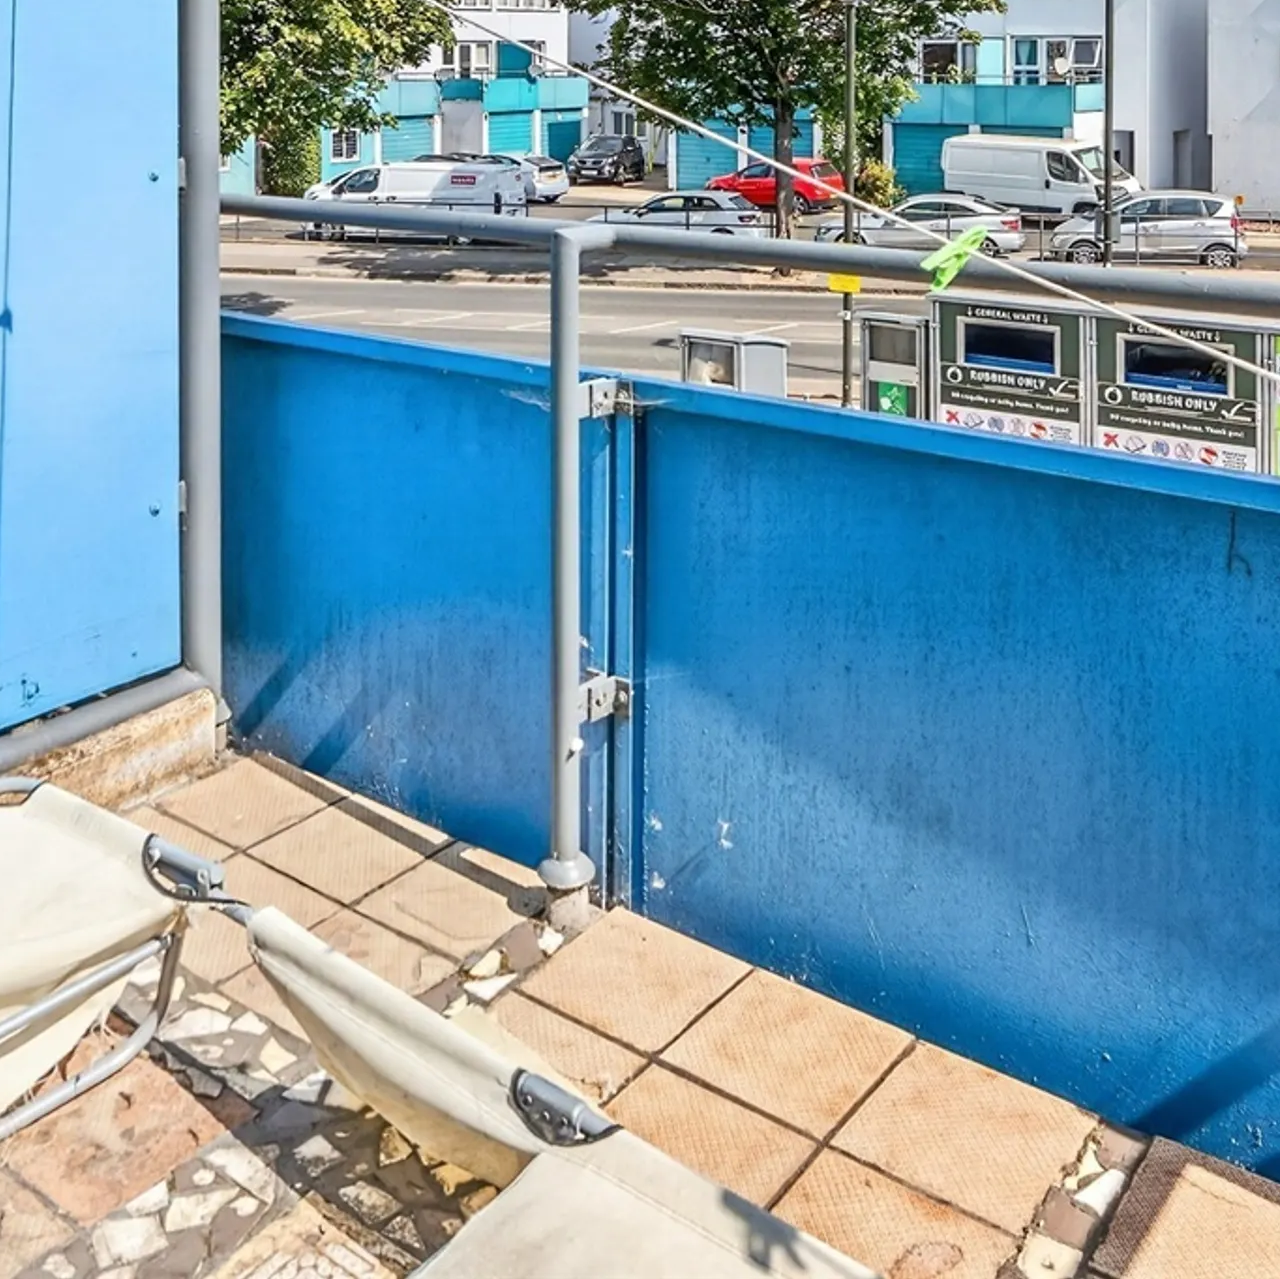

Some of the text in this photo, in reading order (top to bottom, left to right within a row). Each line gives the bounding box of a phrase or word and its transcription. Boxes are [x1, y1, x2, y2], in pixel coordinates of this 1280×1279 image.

[974, 307, 1041, 323] GENERAL WASTE
[969, 370, 1046, 390] RUBBISH ONLY
[1131, 390, 1218, 412] RUBBISH ONLY
